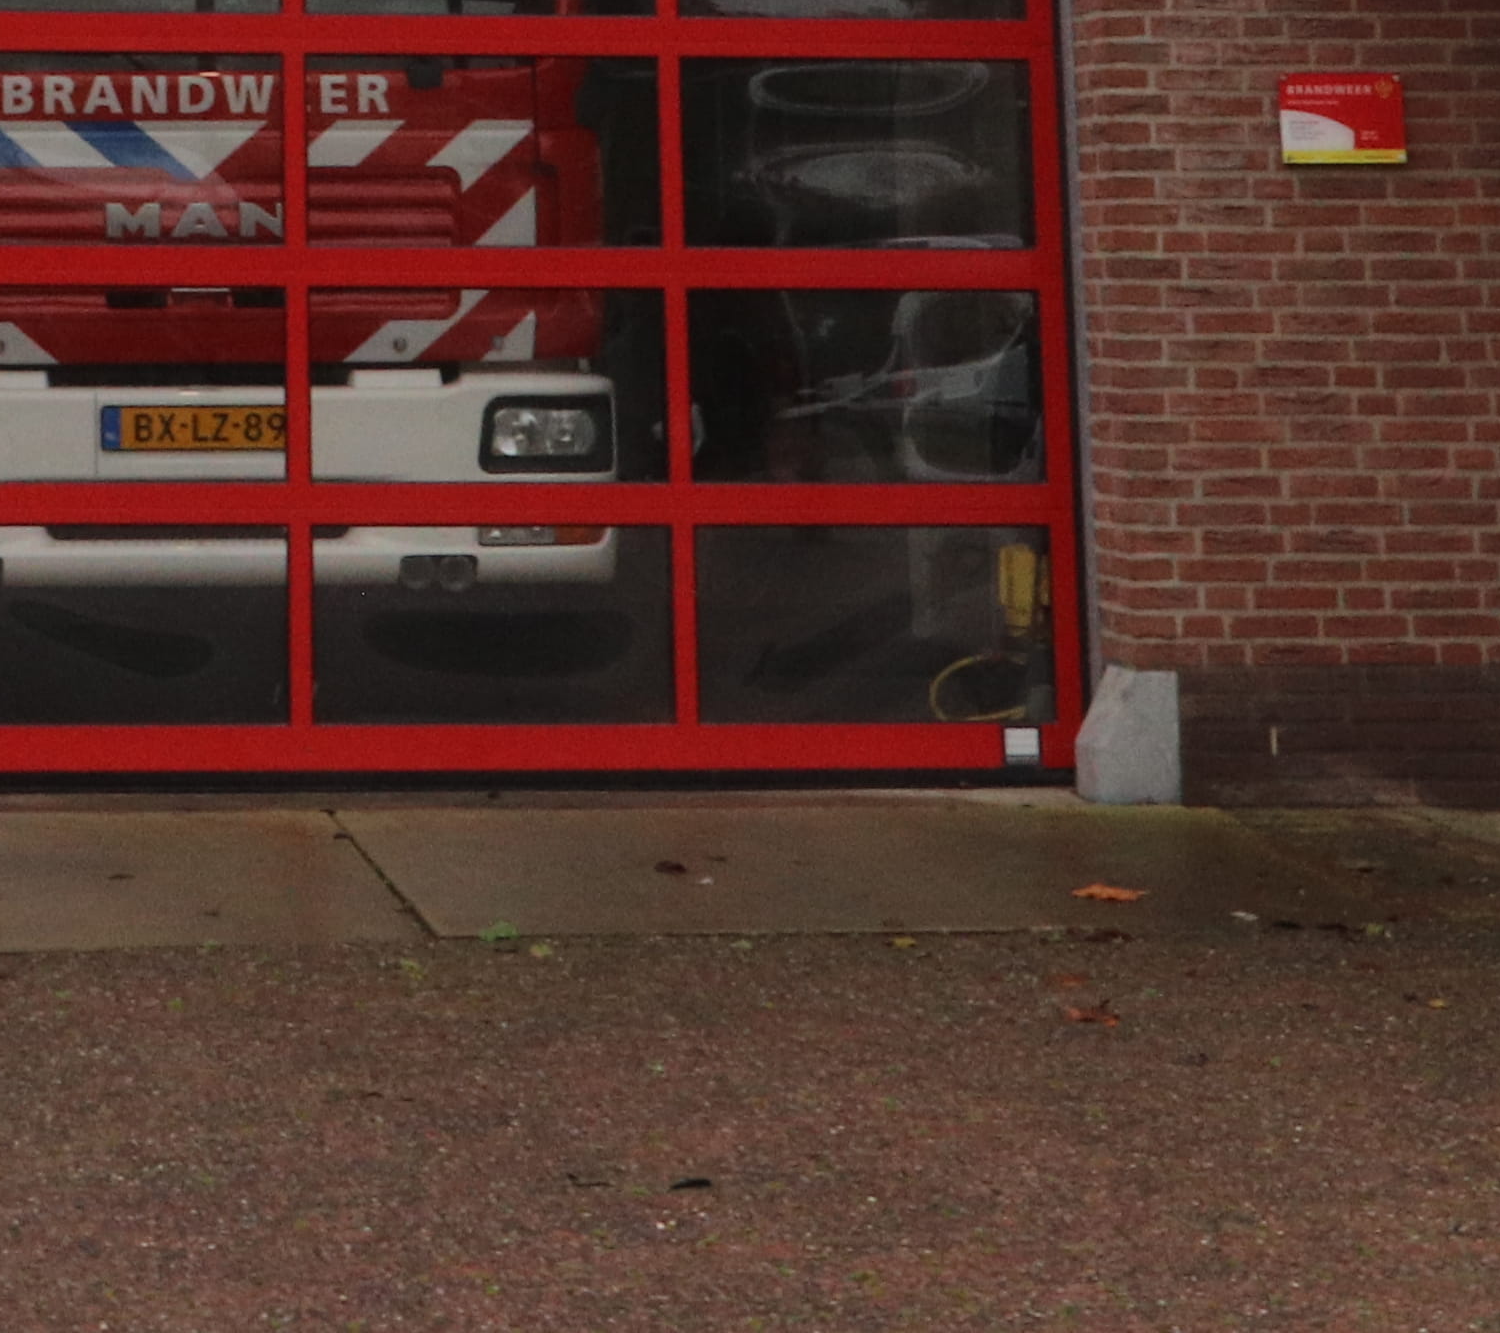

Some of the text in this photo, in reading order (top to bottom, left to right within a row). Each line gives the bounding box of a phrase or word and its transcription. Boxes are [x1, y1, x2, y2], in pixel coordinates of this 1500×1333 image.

[1, 74, 390, 115] BRANDWER
[1286, 84, 1372, 95] BRANDWEER
[105, 201, 284, 238] MAN
[134, 412, 287, 443] BX-LZ-89
